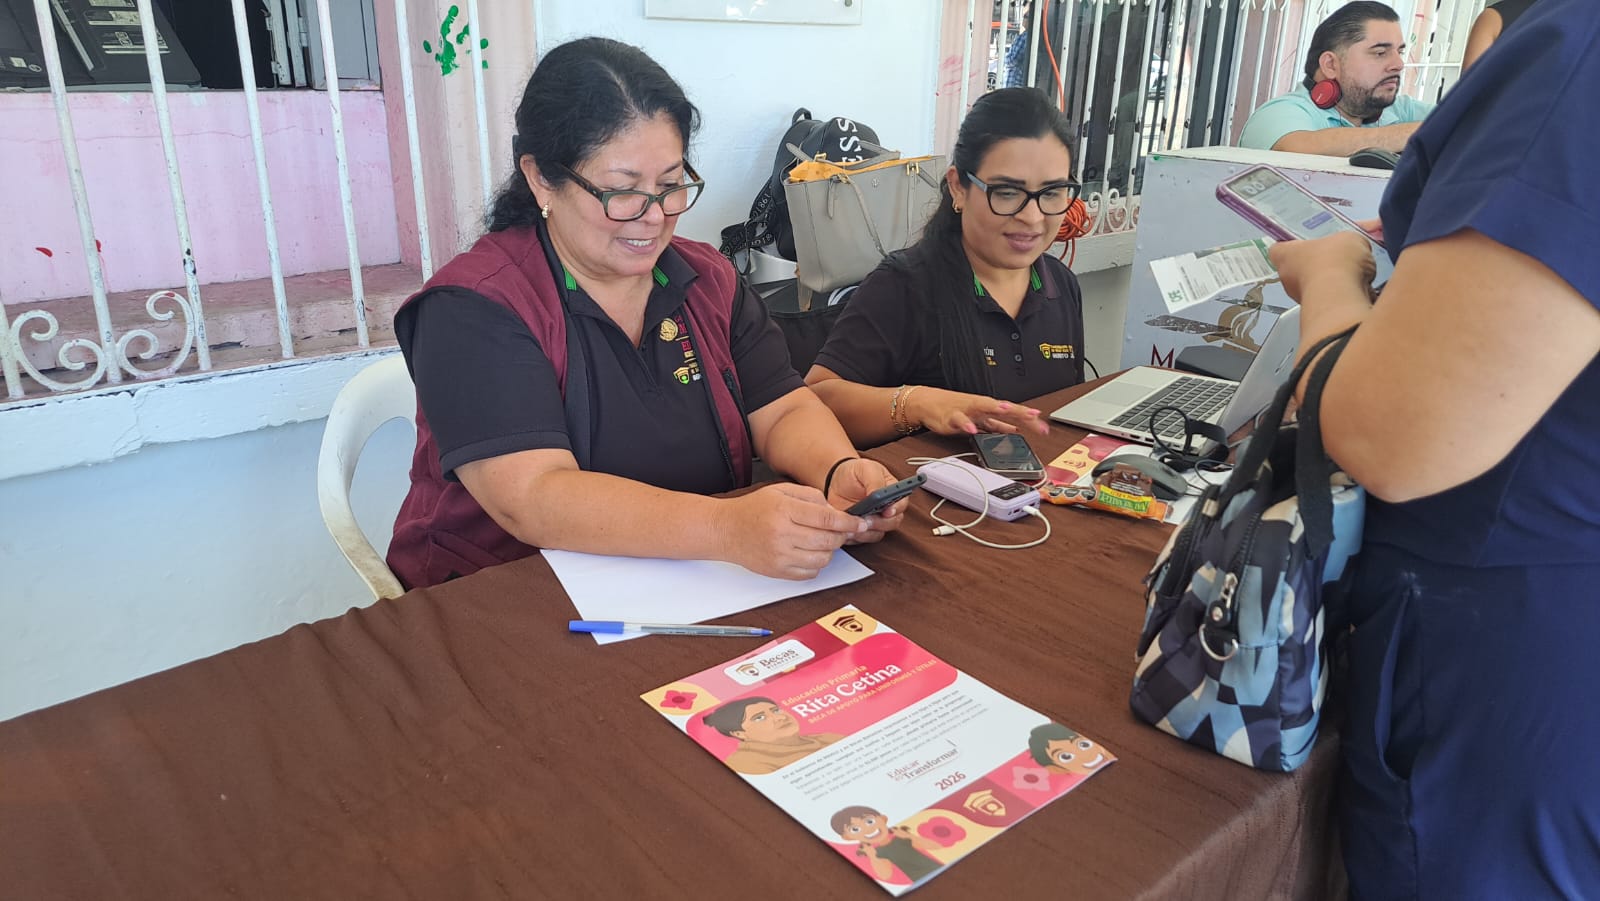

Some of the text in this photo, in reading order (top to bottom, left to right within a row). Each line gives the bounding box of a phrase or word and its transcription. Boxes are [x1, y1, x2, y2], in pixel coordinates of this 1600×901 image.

[1150, 343, 1176, 369] M
[759, 648, 796, 667] Becas
[767, 653, 799, 669] BIENESTAR
[782, 665, 867, 706] Educación Primaria
[791, 693, 840, 718] Rita
[836, 664, 902, 696] Cetina
[807, 711, 827, 724] BECA
[826, 707, 836, 716] DE
[836, 697, 860, 711] APOYO
[859, 689, 875, 700] PARA
[875, 671, 913, 692] UNIFORMES
[886, 759, 920, 779] Educar
[903, 748, 958, 780] Transformar
[934, 771, 967, 791] 2026
